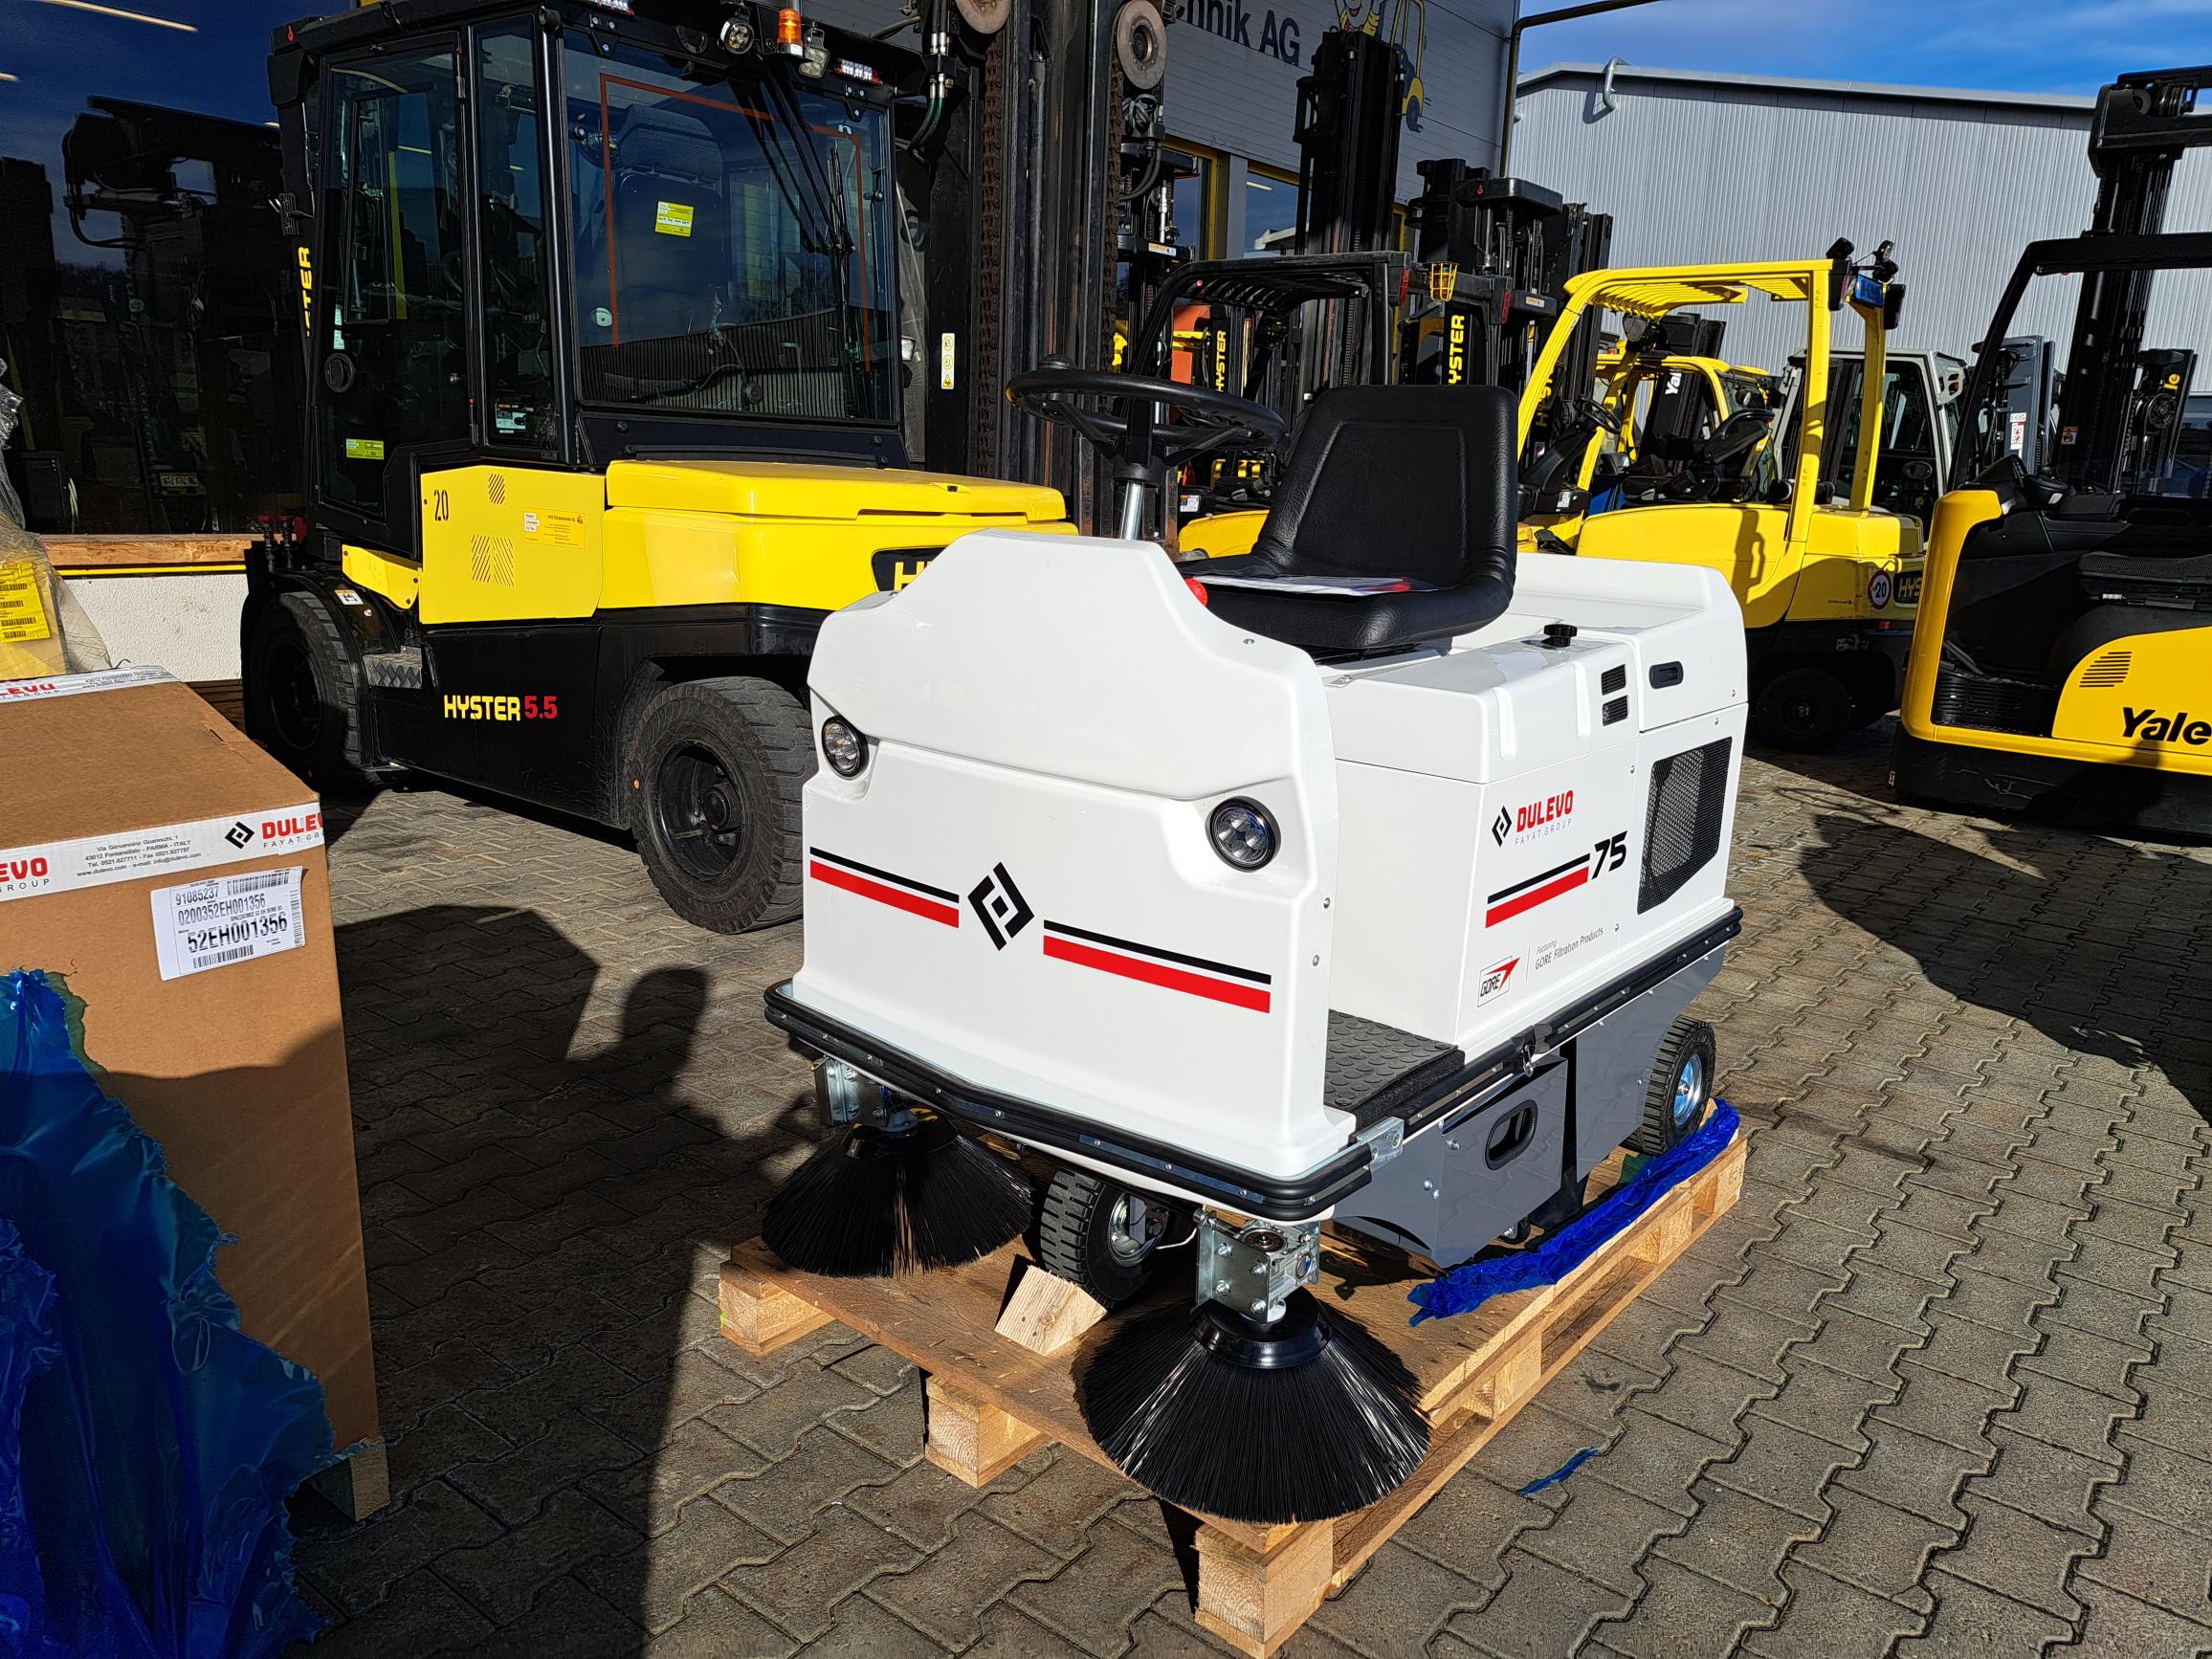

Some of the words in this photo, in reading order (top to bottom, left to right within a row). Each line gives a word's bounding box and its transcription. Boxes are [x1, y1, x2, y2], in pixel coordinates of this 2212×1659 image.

[1259, 10, 1300, 66] AG
[1215, 330, 1226, 393] HYSTER
[1448, 314, 1465, 386] YSTER
[1875, 581, 1887, 599] 20
[444, 695, 520, 721] HYSTER
[524, 696, 558, 719] 5.5
[2122, 706, 2211, 745] Yale
[1516, 790, 1574, 832] DULEVO
[108, 841, 142, 850] Giovannino
[263, 836, 302, 850] FAYAT
[1515, 830, 1541, 847] FAYAT
[1543, 818, 1572, 836] GROUP
[104, 848, 142, 858] Fontanellato
[146, 843, 168, 852] PARMA
[174, 839, 191, 848] ITALY
[1591, 830, 1627, 880] 75
[77, 864, 127, 876] www.dulevo.com
[0, 878, 50, 893] ROUP
[176, 886, 219, 906] 91085237
[178, 894, 266, 925] 0200352EH001356
[188, 911, 288, 953] 52EH001356
[1535, 954, 1552, 970] GORE
[1554, 940, 1579, 961] Filtration
[1580, 926, 1604, 947] Products
[1537, 939, 1558, 955] Featuring
[1480, 973, 1501, 997] GORE
